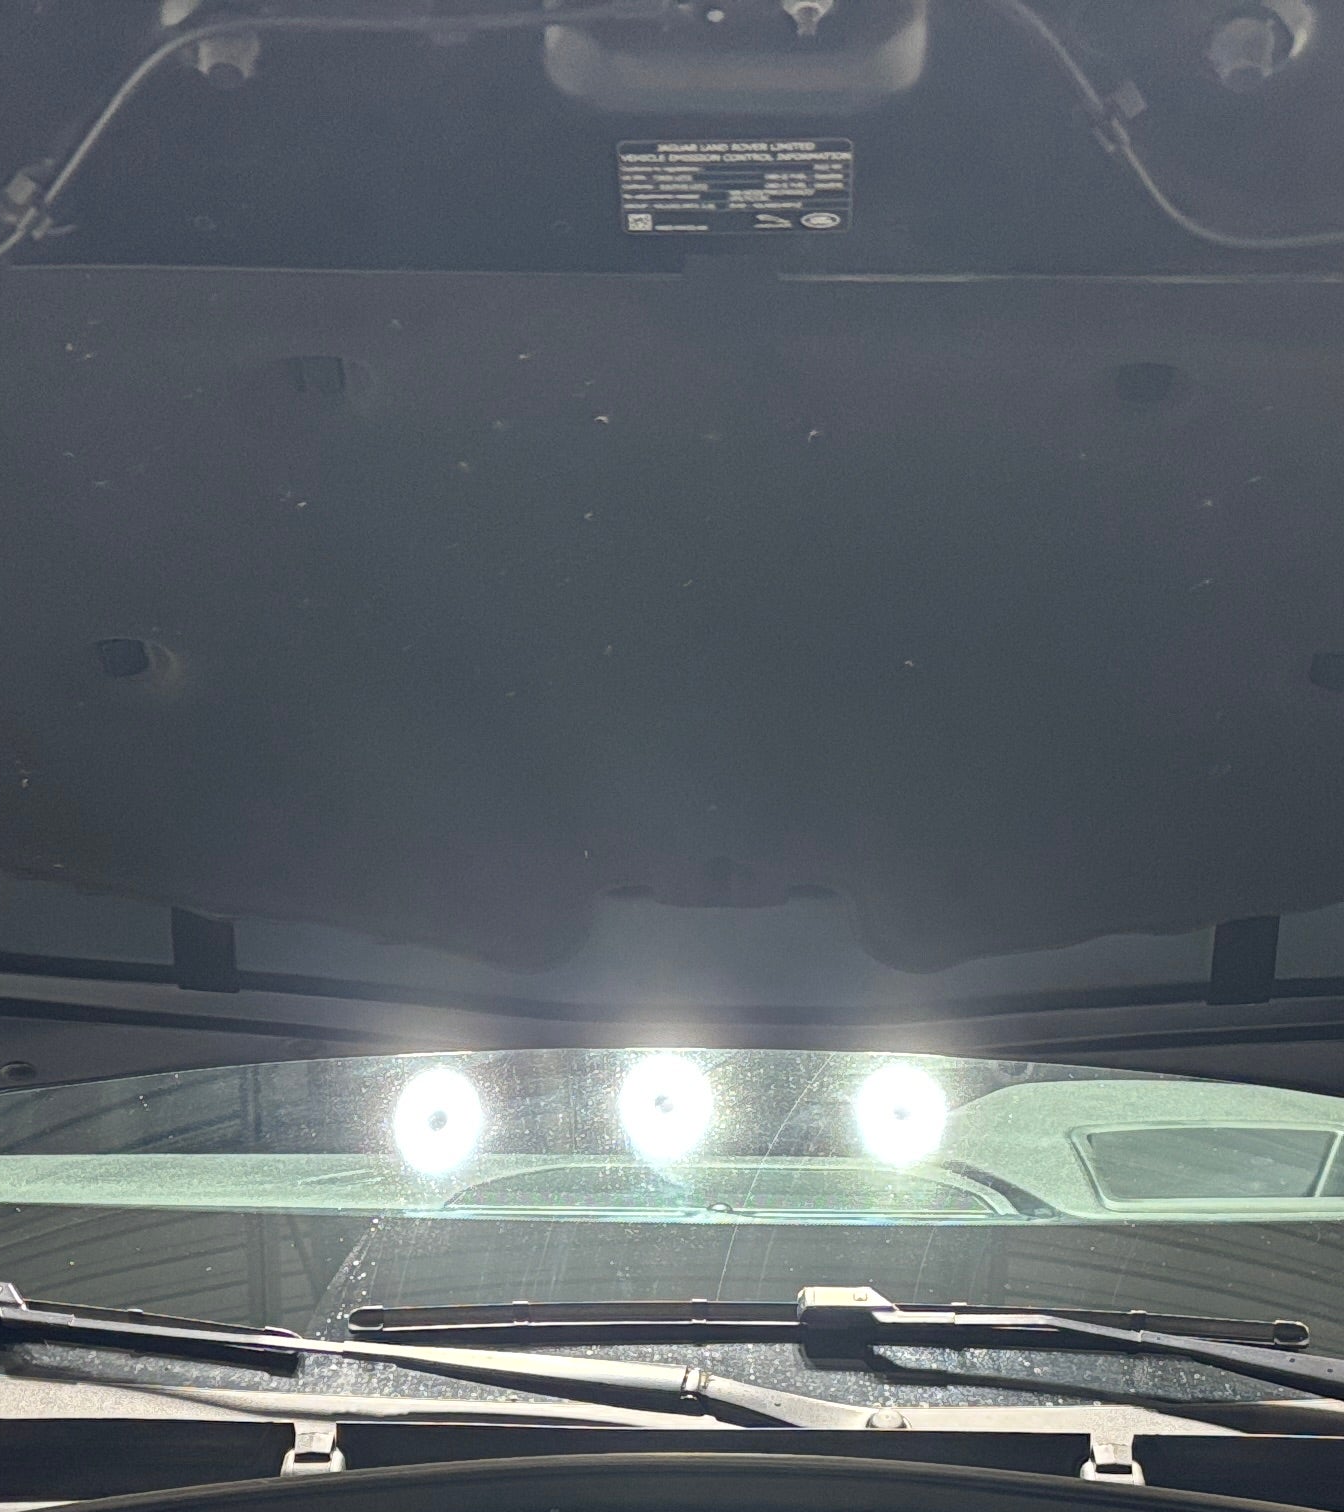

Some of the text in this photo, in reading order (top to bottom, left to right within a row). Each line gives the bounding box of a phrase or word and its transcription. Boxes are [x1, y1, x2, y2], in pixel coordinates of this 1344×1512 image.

[656, 141, 816, 152] JAGUAR LAND ROVER LIMITED
[620, 151, 853, 163] VEHICLE EMISSION CONTROL INFORMATION
